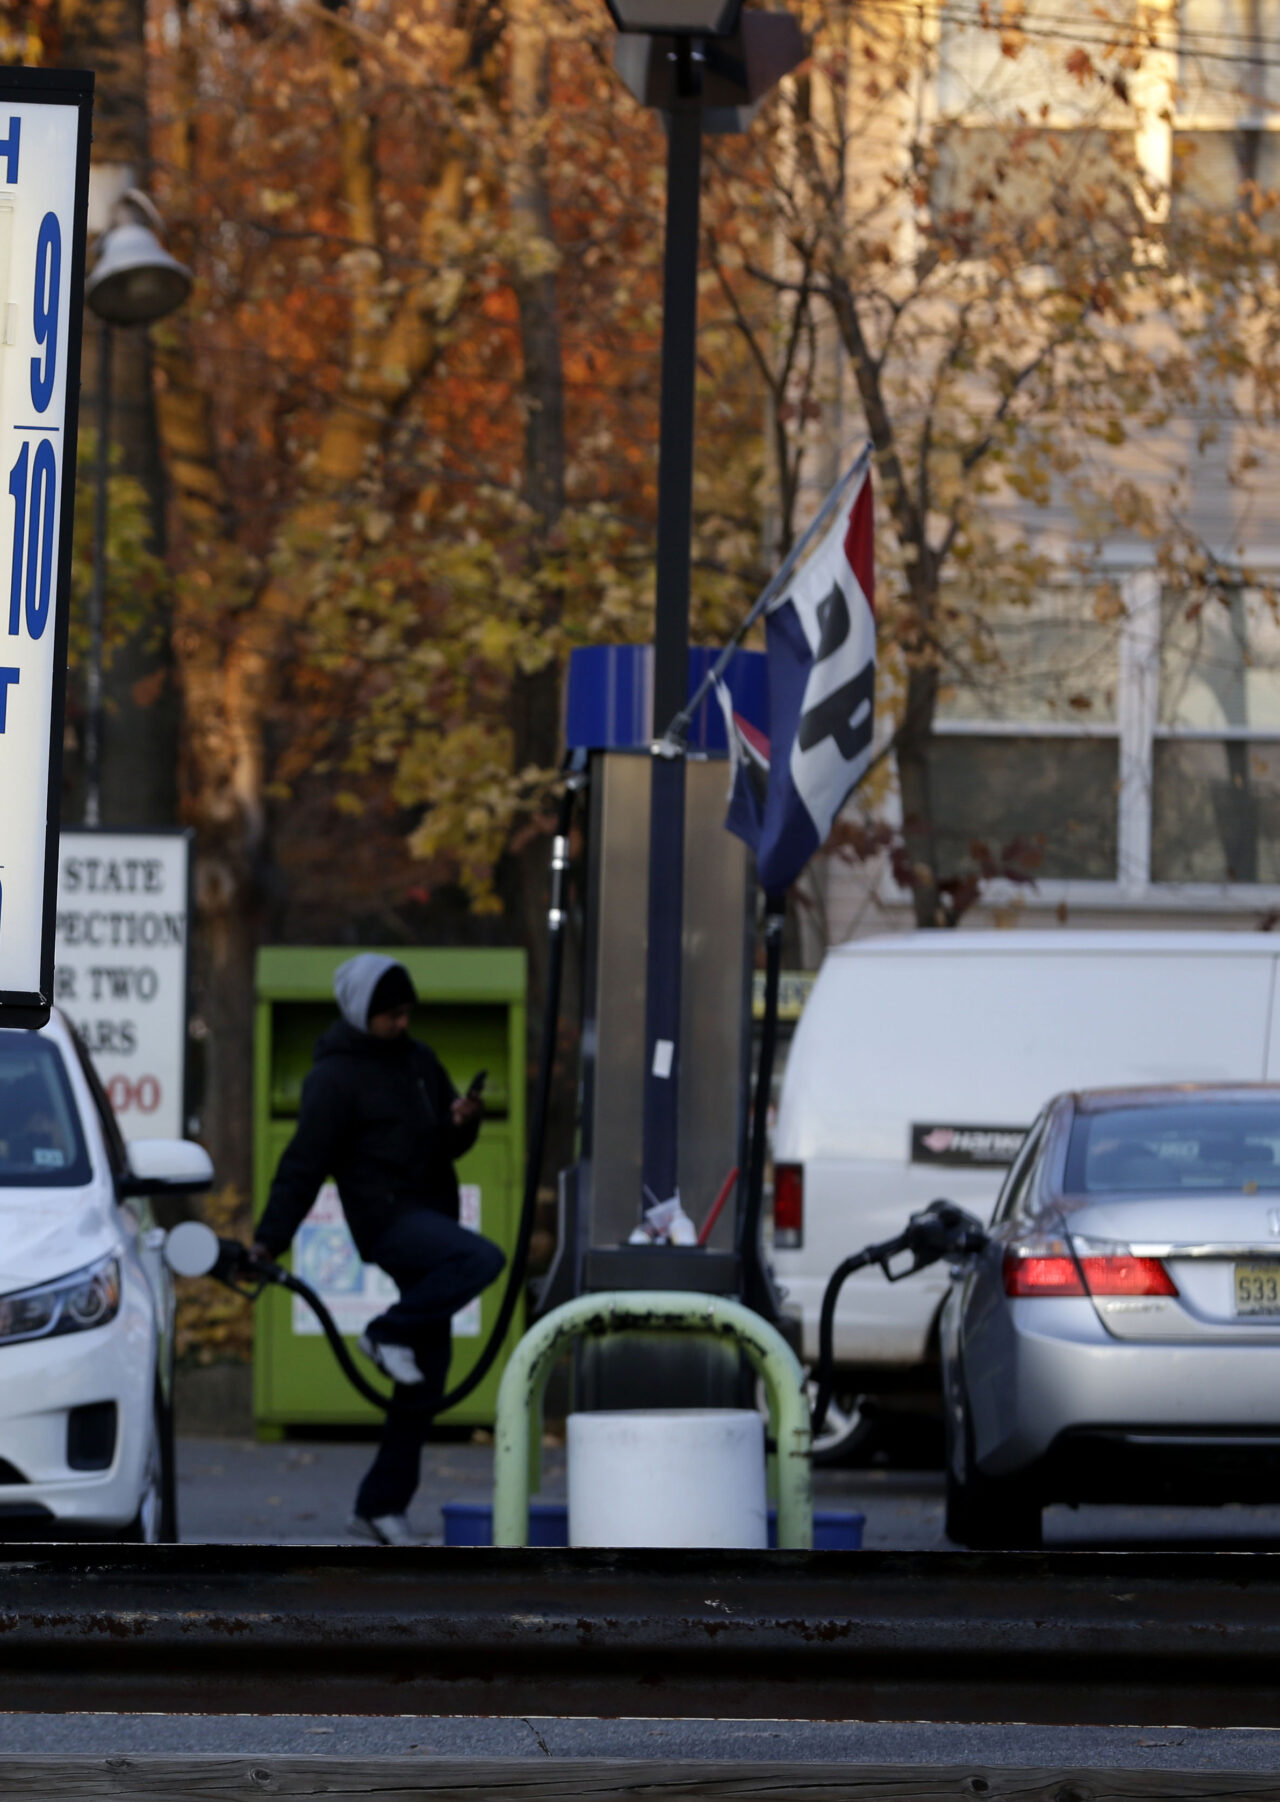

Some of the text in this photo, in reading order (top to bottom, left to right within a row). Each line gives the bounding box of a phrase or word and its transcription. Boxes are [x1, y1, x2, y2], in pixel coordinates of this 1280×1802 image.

[31, 211, 62, 413] 9
[9, 439, 57, 640] 10
[63, 858, 165, 894] STATE
[88, 965, 160, 1003] TWO
